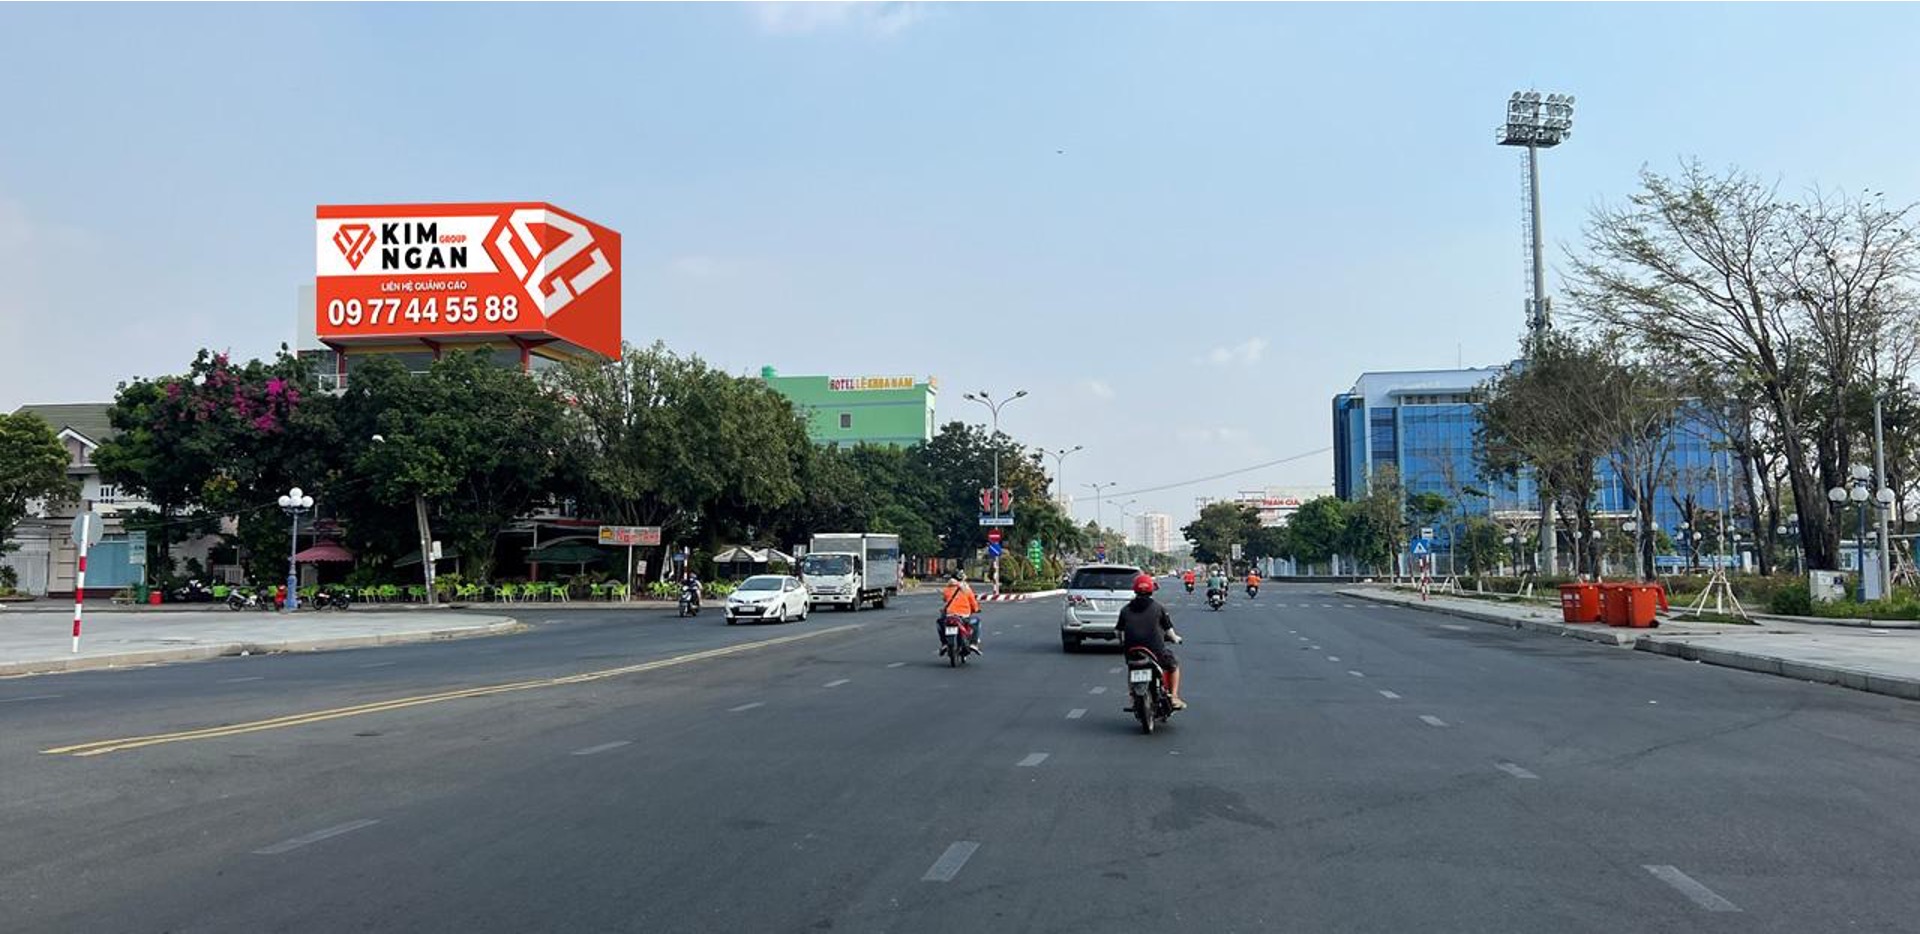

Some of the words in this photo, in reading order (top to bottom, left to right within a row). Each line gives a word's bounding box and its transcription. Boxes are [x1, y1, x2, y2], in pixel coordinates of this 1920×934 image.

[382, 222, 437, 245] KIM
[439, 234, 467, 244] GROUP
[382, 246, 467, 270] NGAN
[328, 298, 362, 326] 09
[367, 298, 401, 325] 77
[404, 297, 438, 323] 44
[445, 296, 478, 323] 55
[485, 295, 518, 322] 88
[829, 378, 854, 390] HOTEL
